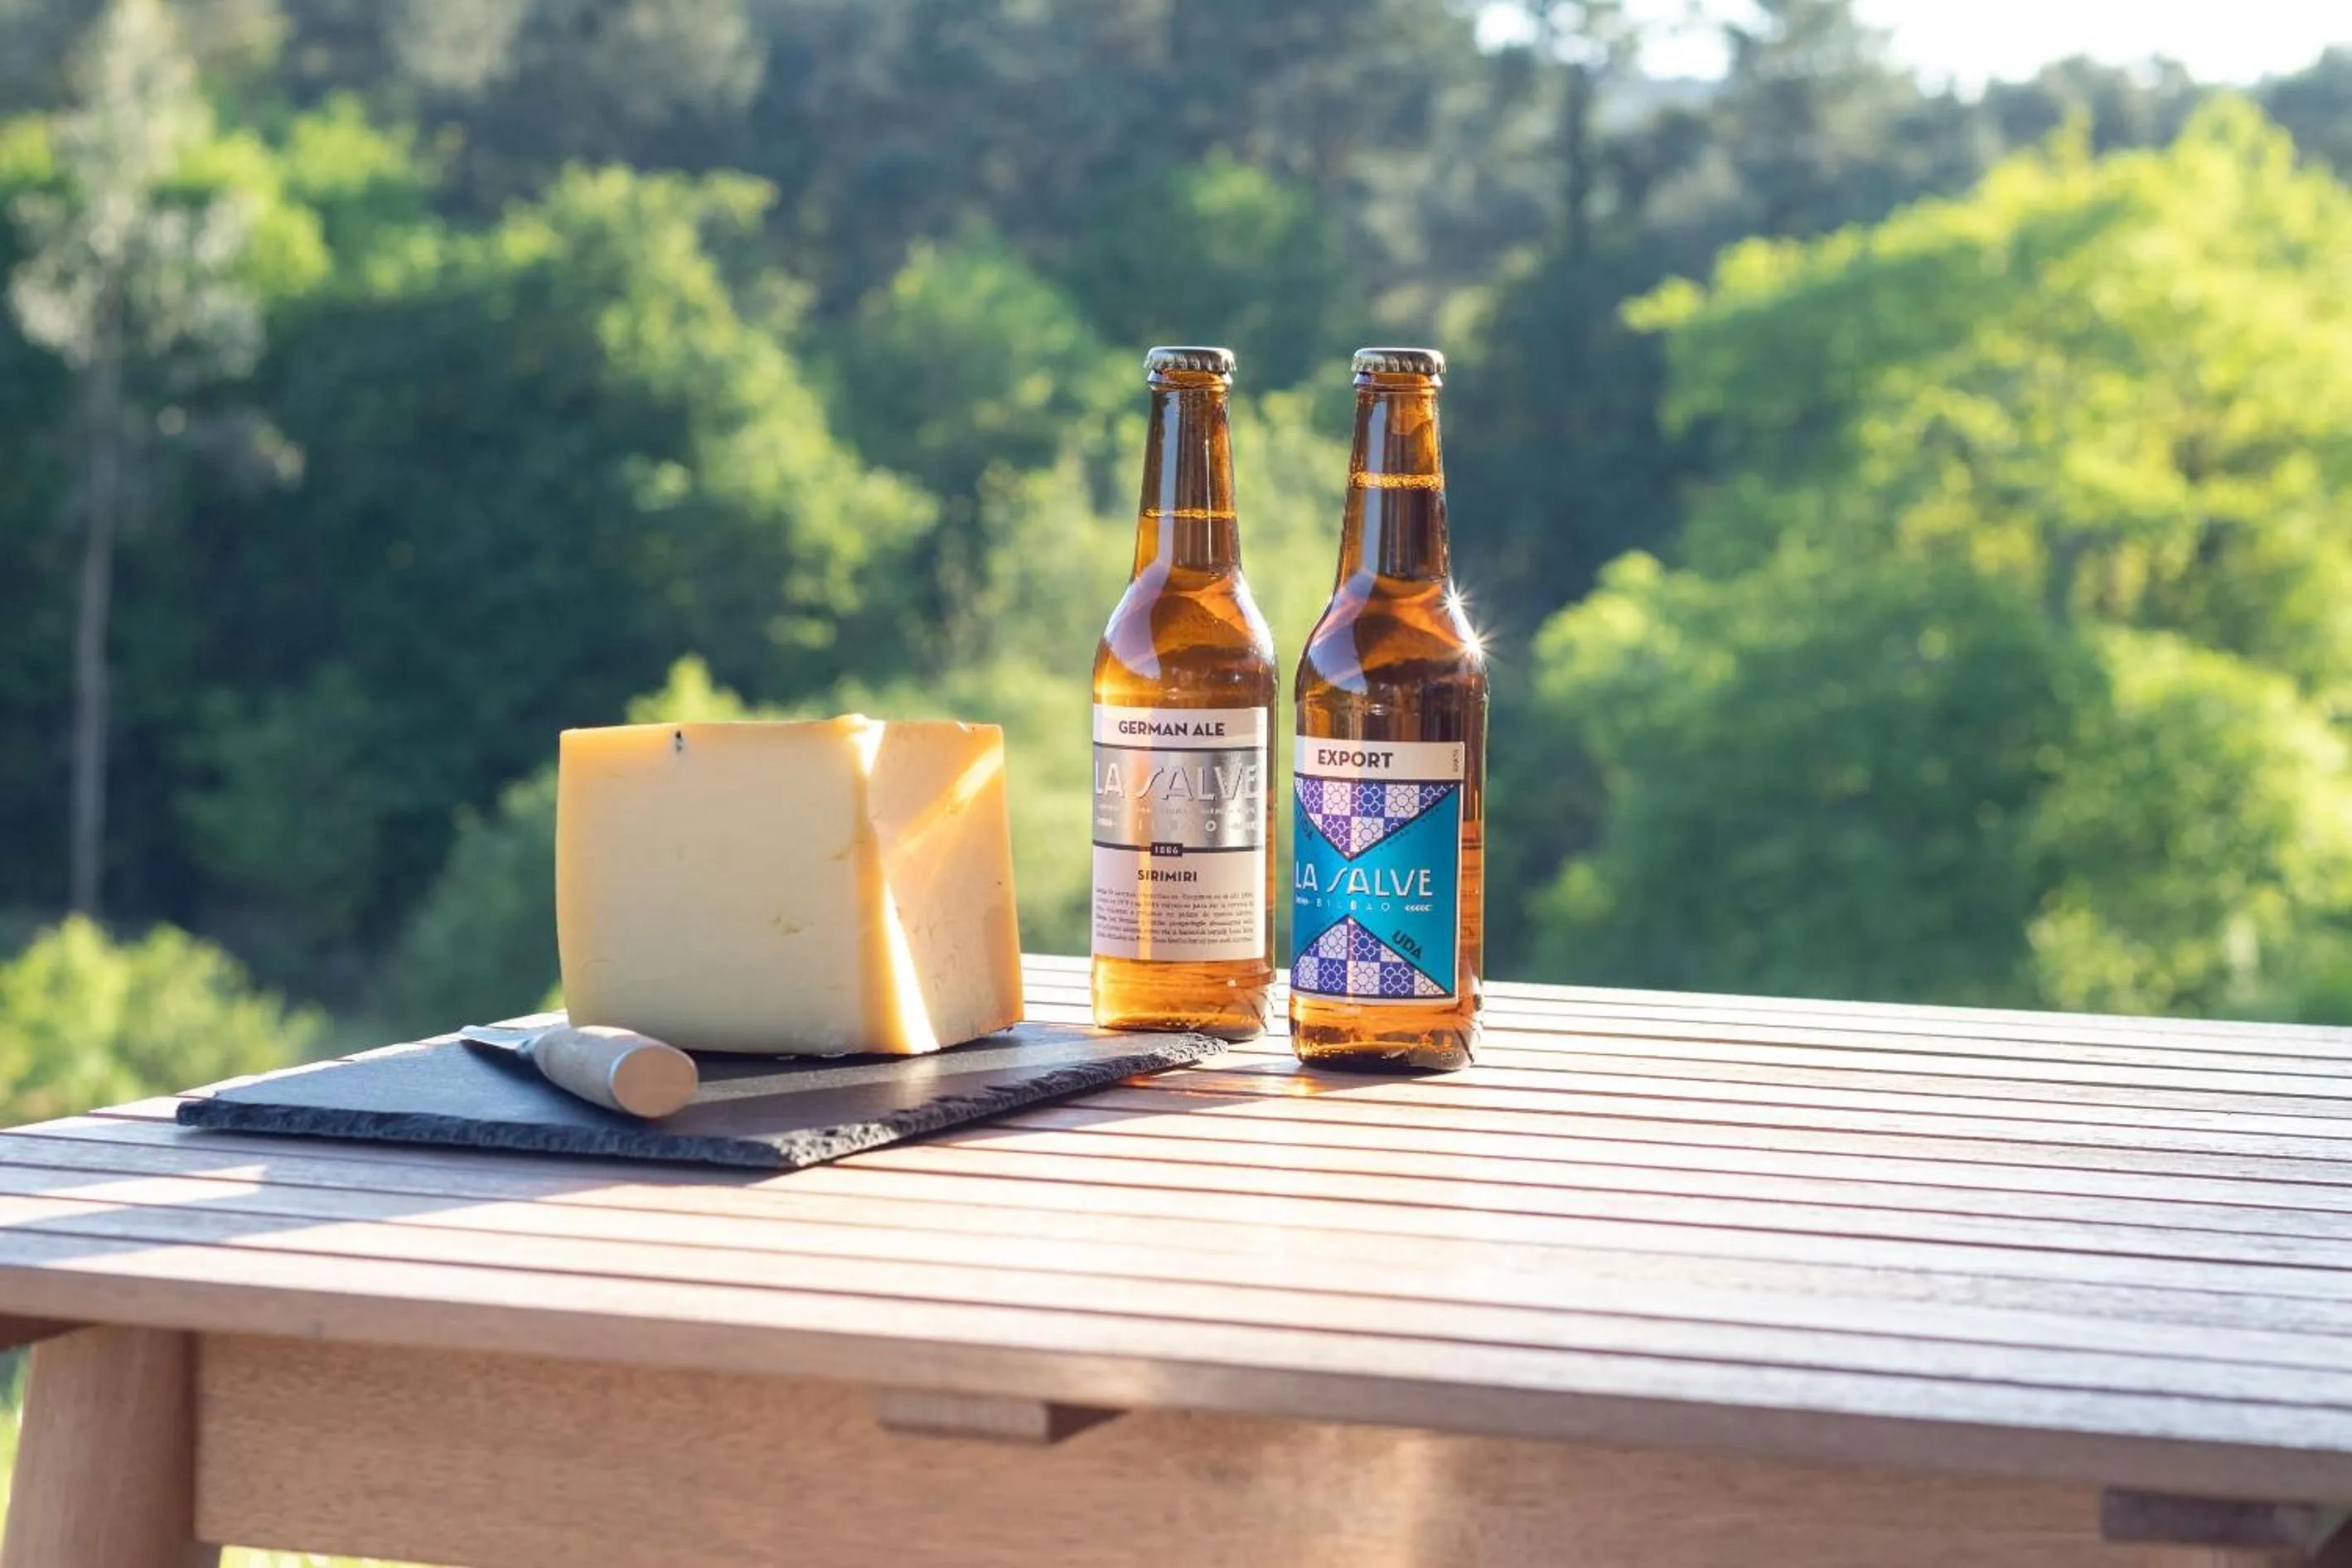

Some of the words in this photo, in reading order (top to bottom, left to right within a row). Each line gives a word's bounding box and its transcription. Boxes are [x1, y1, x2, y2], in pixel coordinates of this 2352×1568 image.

[1119, 720, 1188, 737] GERMAN
[1193, 722, 1225, 737] ALE
[1318, 749, 1393, 768] EXPORT
[1095, 758, 1125, 799] LA
[1126, 762, 1262, 803] SALVE
[1137, 869, 1198, 883] SIRIMIRI
[1295, 860, 1318, 892] LA
[1326, 867, 1434, 898] SALVE
[1391, 929, 1425, 961] UDA
